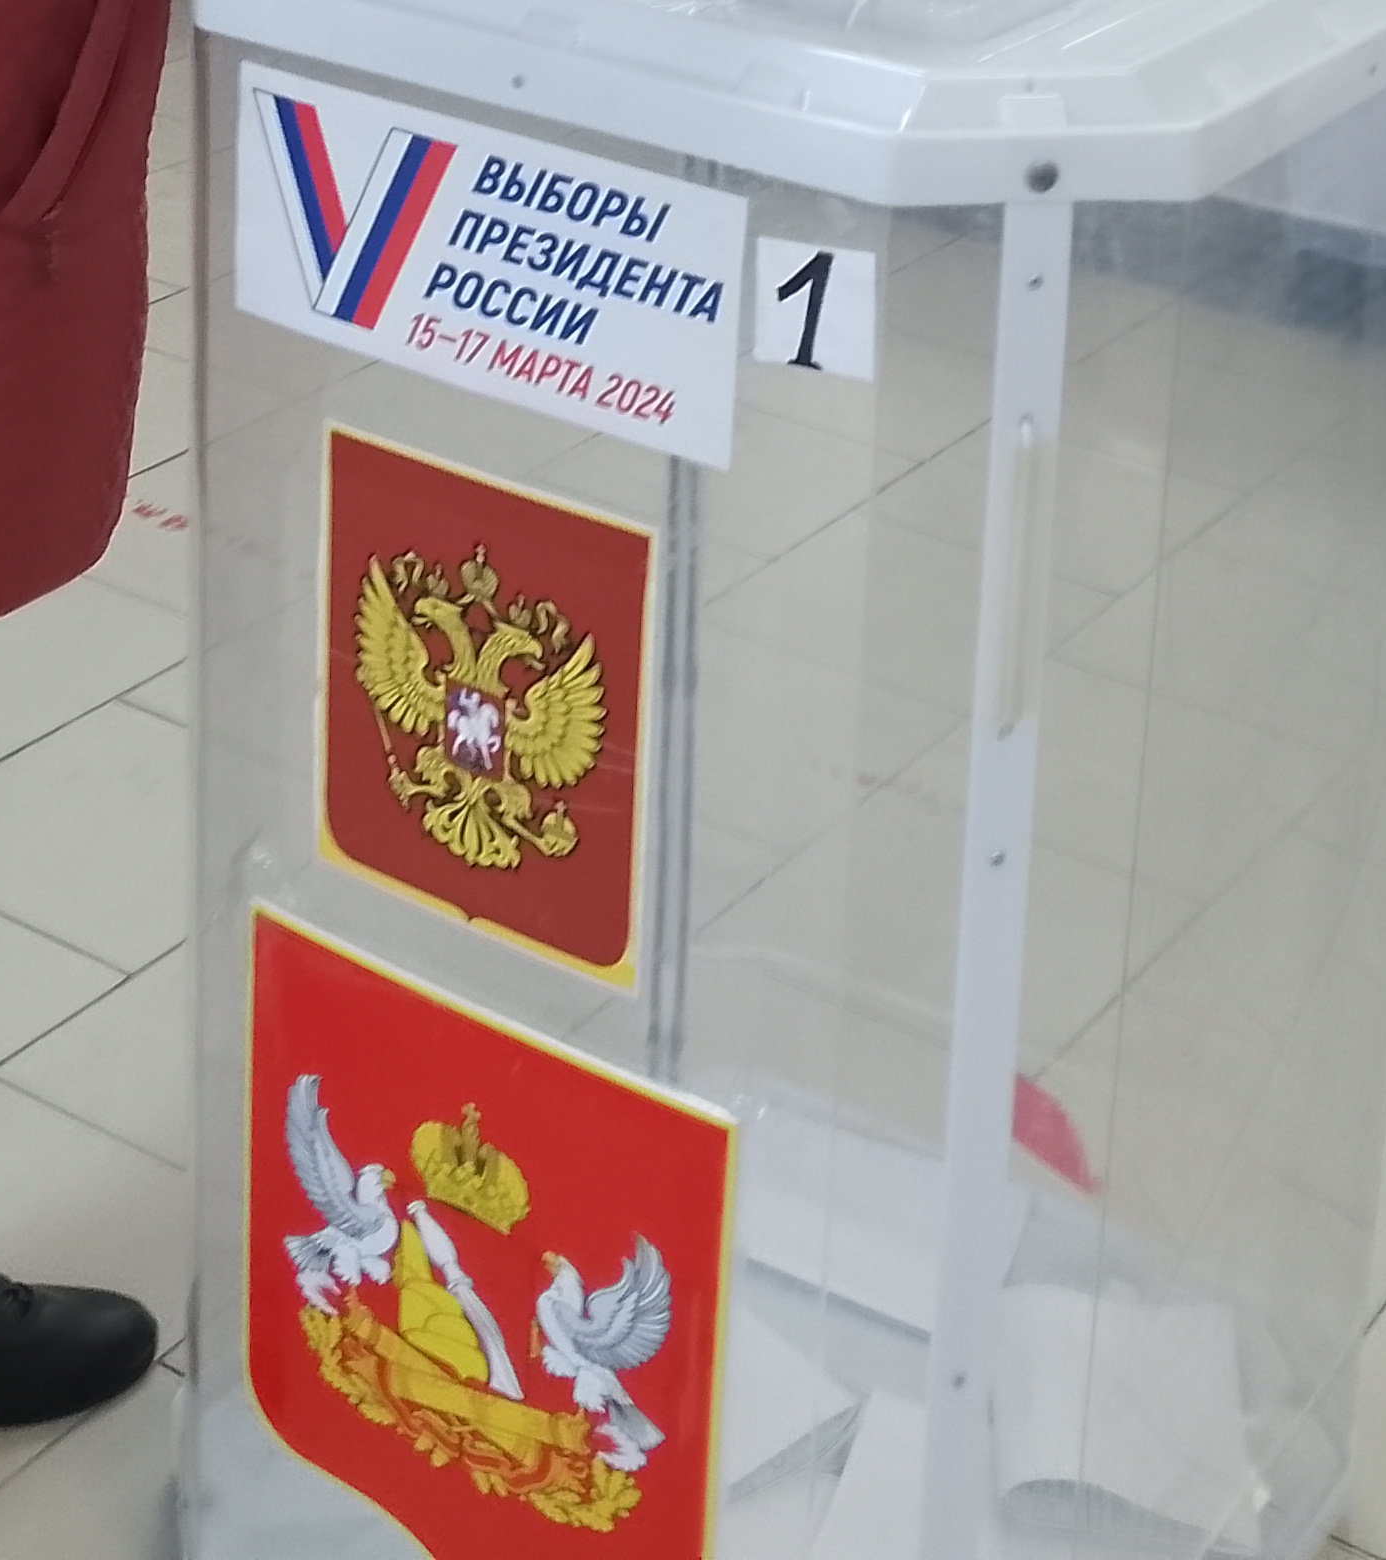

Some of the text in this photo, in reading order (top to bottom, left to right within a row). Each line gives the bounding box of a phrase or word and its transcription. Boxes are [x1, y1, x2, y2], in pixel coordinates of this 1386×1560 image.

[472, 155, 670, 242] ВЫБОРЫ
[423, 262, 600, 345] РОССИИ
[448, 209, 724, 322] ПРЕЗИДЕНТА
[776, 251, 834, 371] 1
[493, 341, 595, 400] МАРТА
[596, 373, 677, 426] 2024
